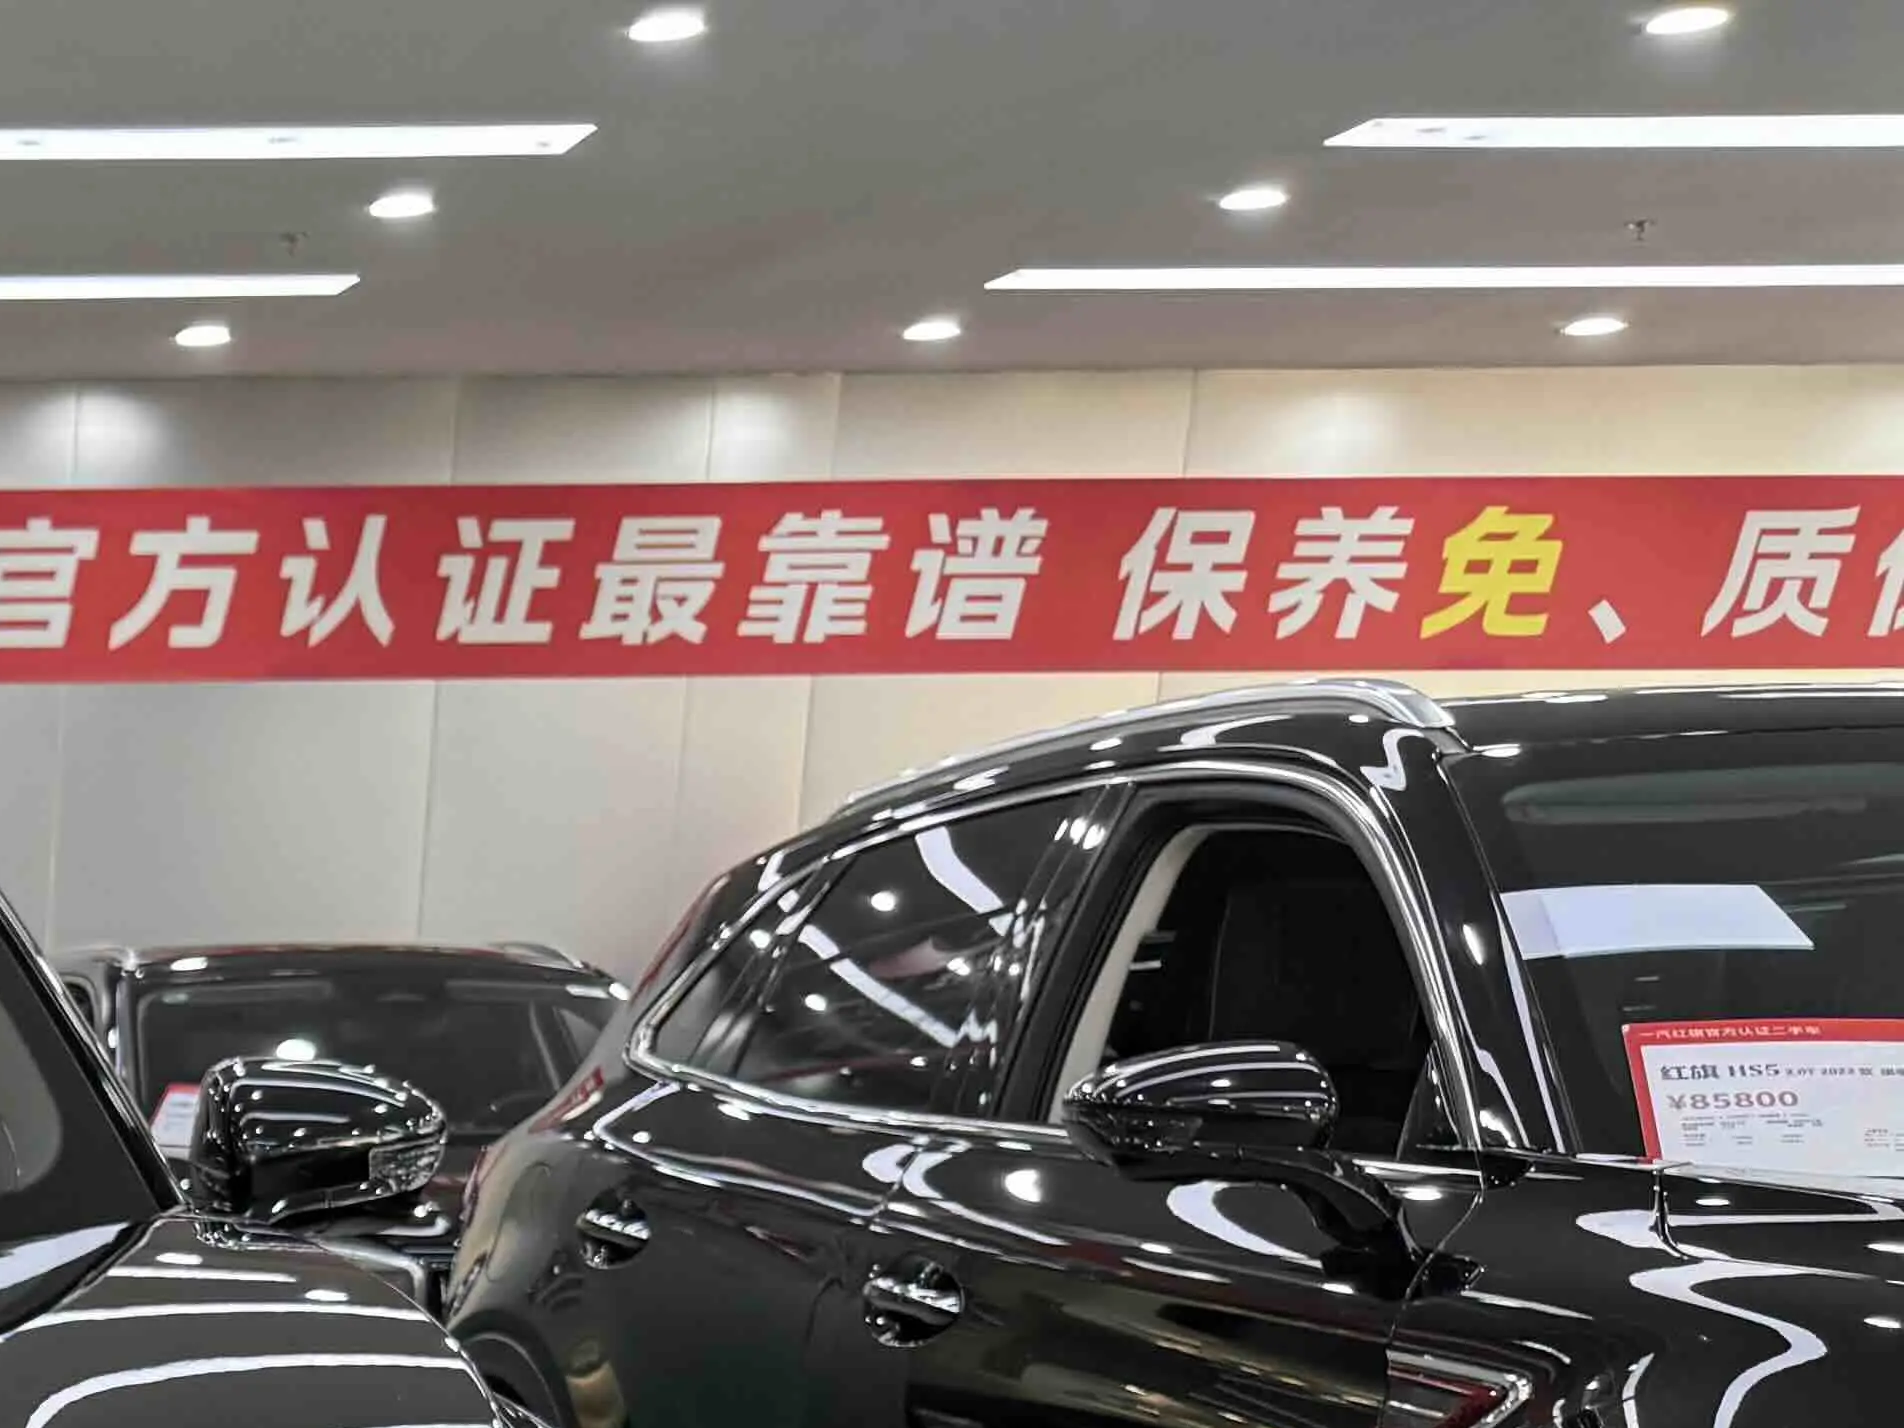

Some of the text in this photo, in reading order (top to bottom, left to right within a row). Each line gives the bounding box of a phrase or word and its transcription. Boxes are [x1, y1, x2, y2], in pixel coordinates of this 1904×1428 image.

[1660, 1063, 1720, 1081] 红旗
[1728, 1063, 1780, 1078] HS5
[1666, 1090, 1800, 1111] ¥85800
